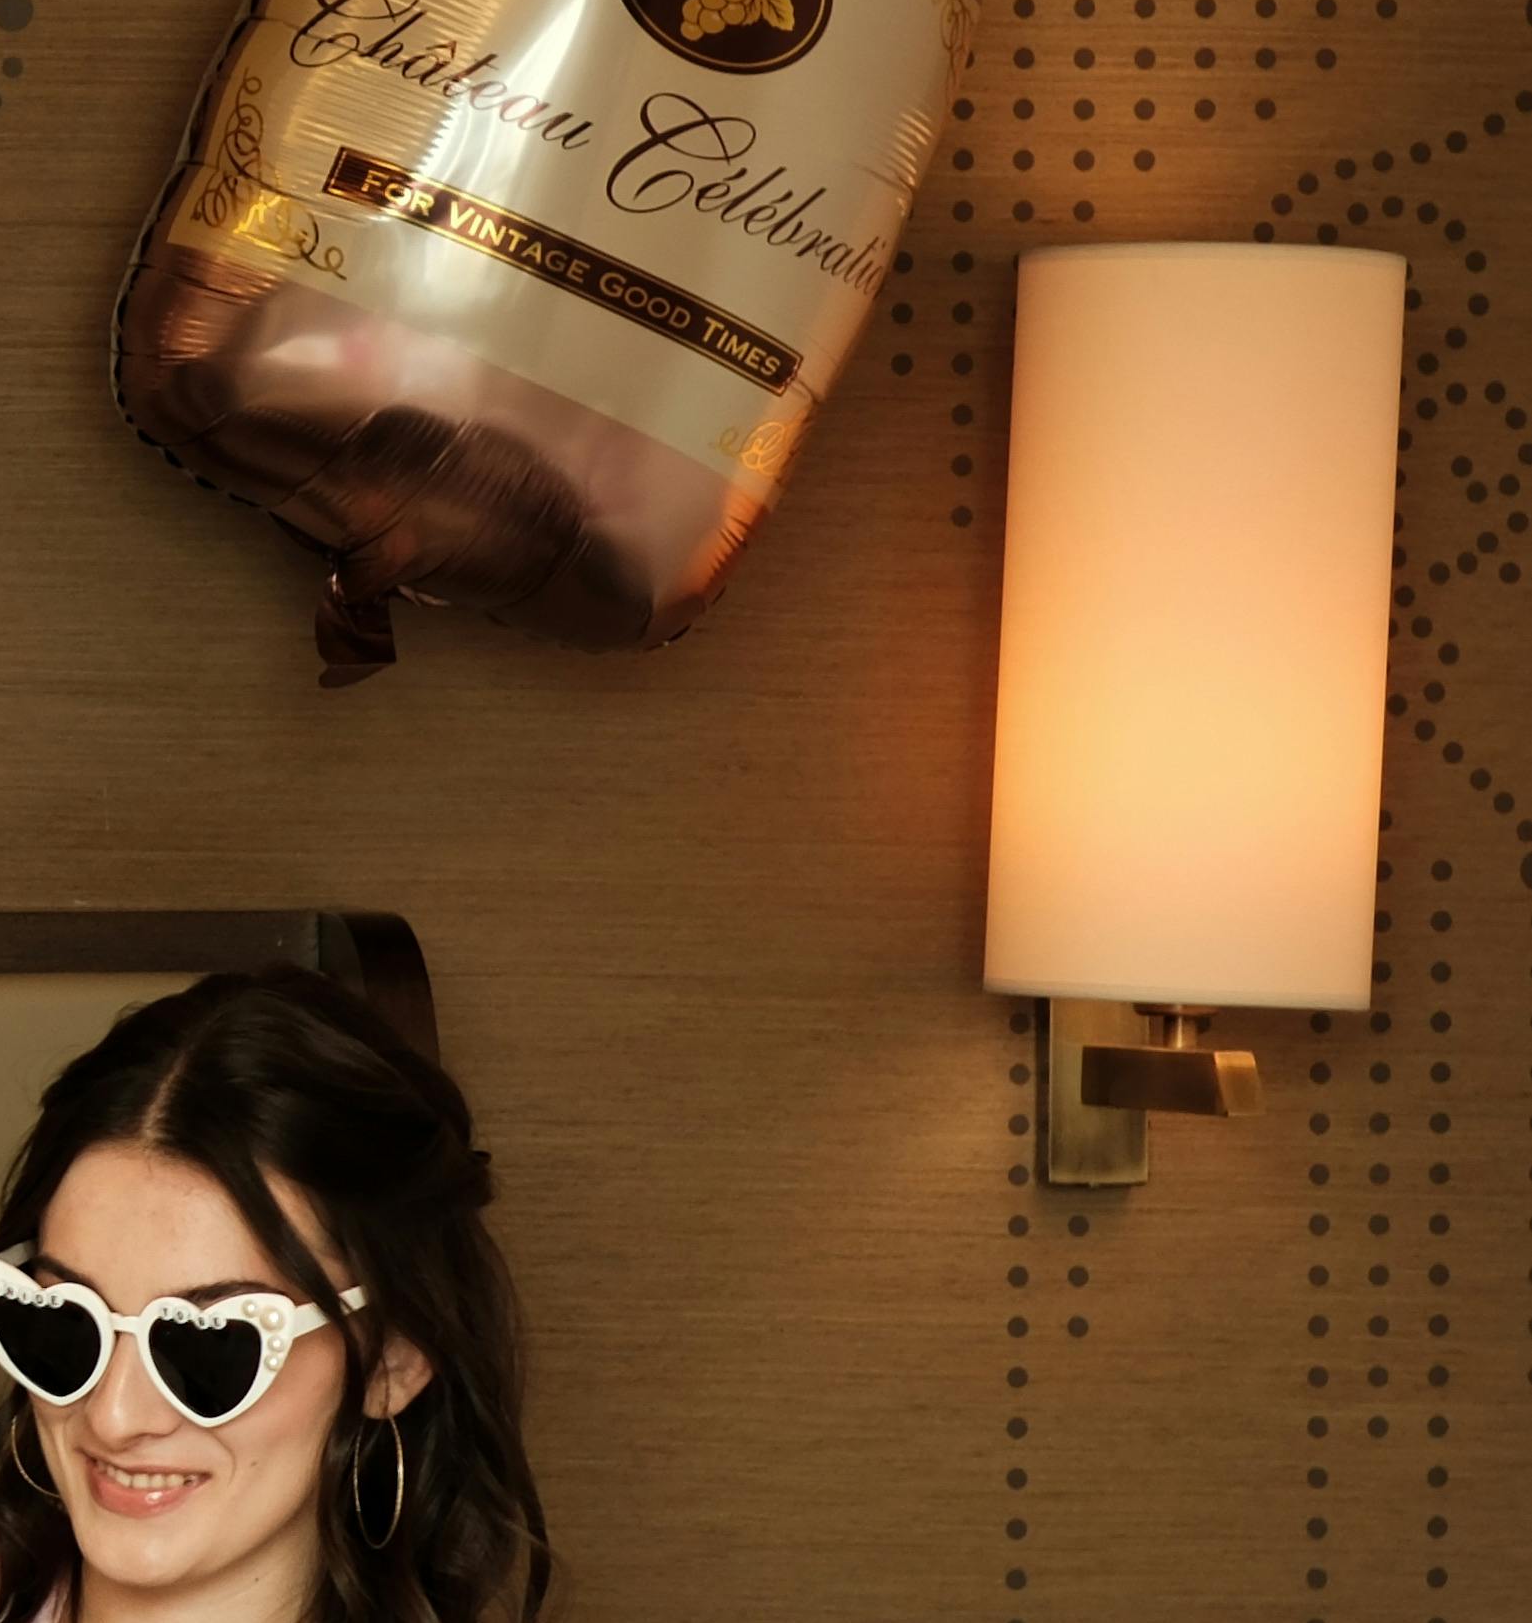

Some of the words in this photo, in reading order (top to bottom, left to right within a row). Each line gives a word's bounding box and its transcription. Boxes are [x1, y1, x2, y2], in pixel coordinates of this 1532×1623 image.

[360, 168, 436, 218] FOR
[446, 201, 593, 285] VINTAGE
[598, 270, 691, 331] GOOD
[703, 315, 782, 377] TIMES
